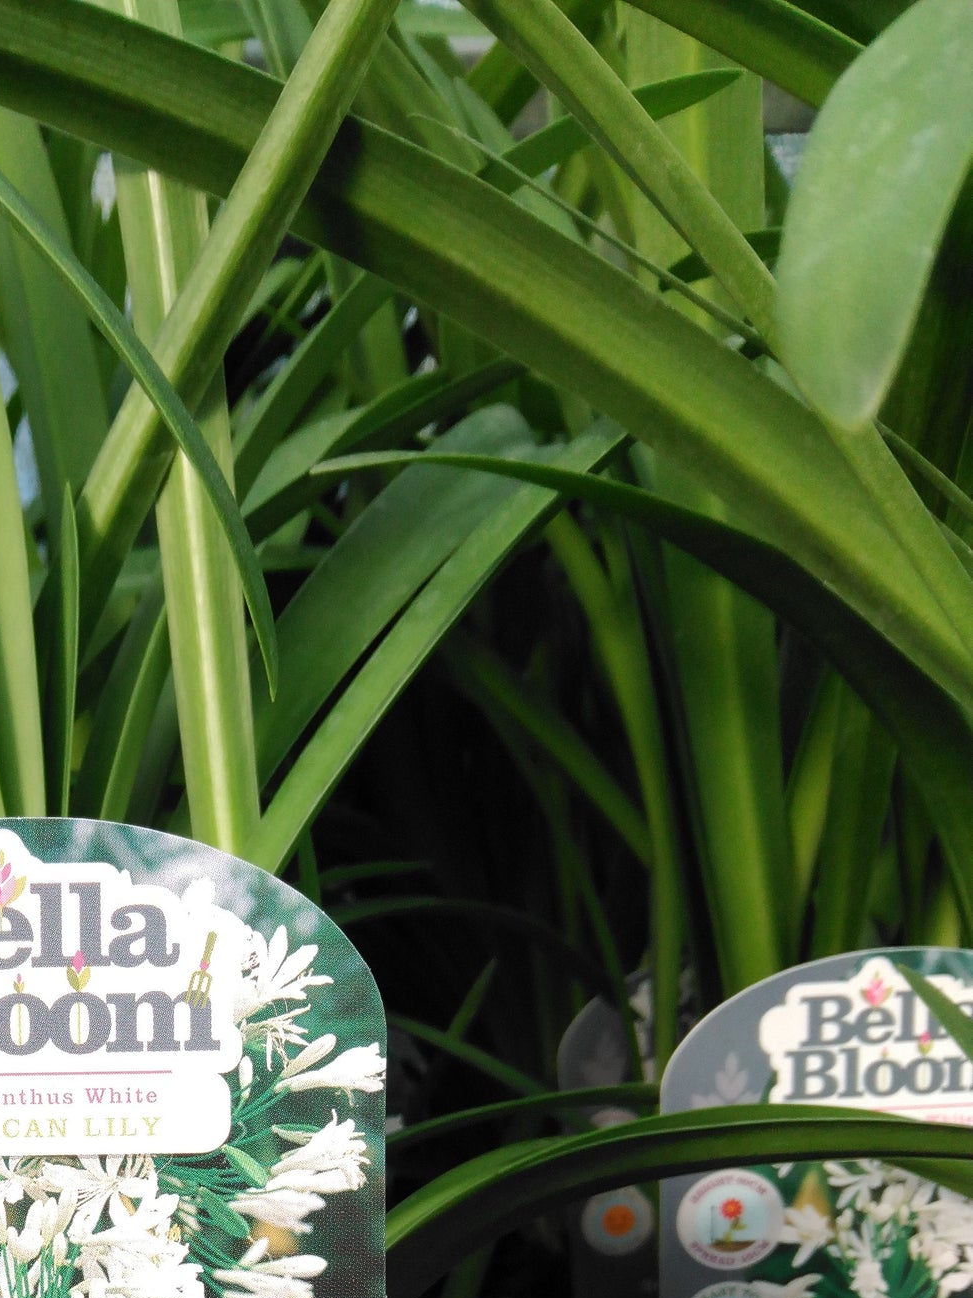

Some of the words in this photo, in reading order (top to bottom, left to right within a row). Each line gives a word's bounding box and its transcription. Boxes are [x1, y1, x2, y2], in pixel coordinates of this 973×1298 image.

[800, 989, 973, 1047] Bell
[85, 1086, 158, 1104] White
[83, 1116, 161, 1138] LILY
